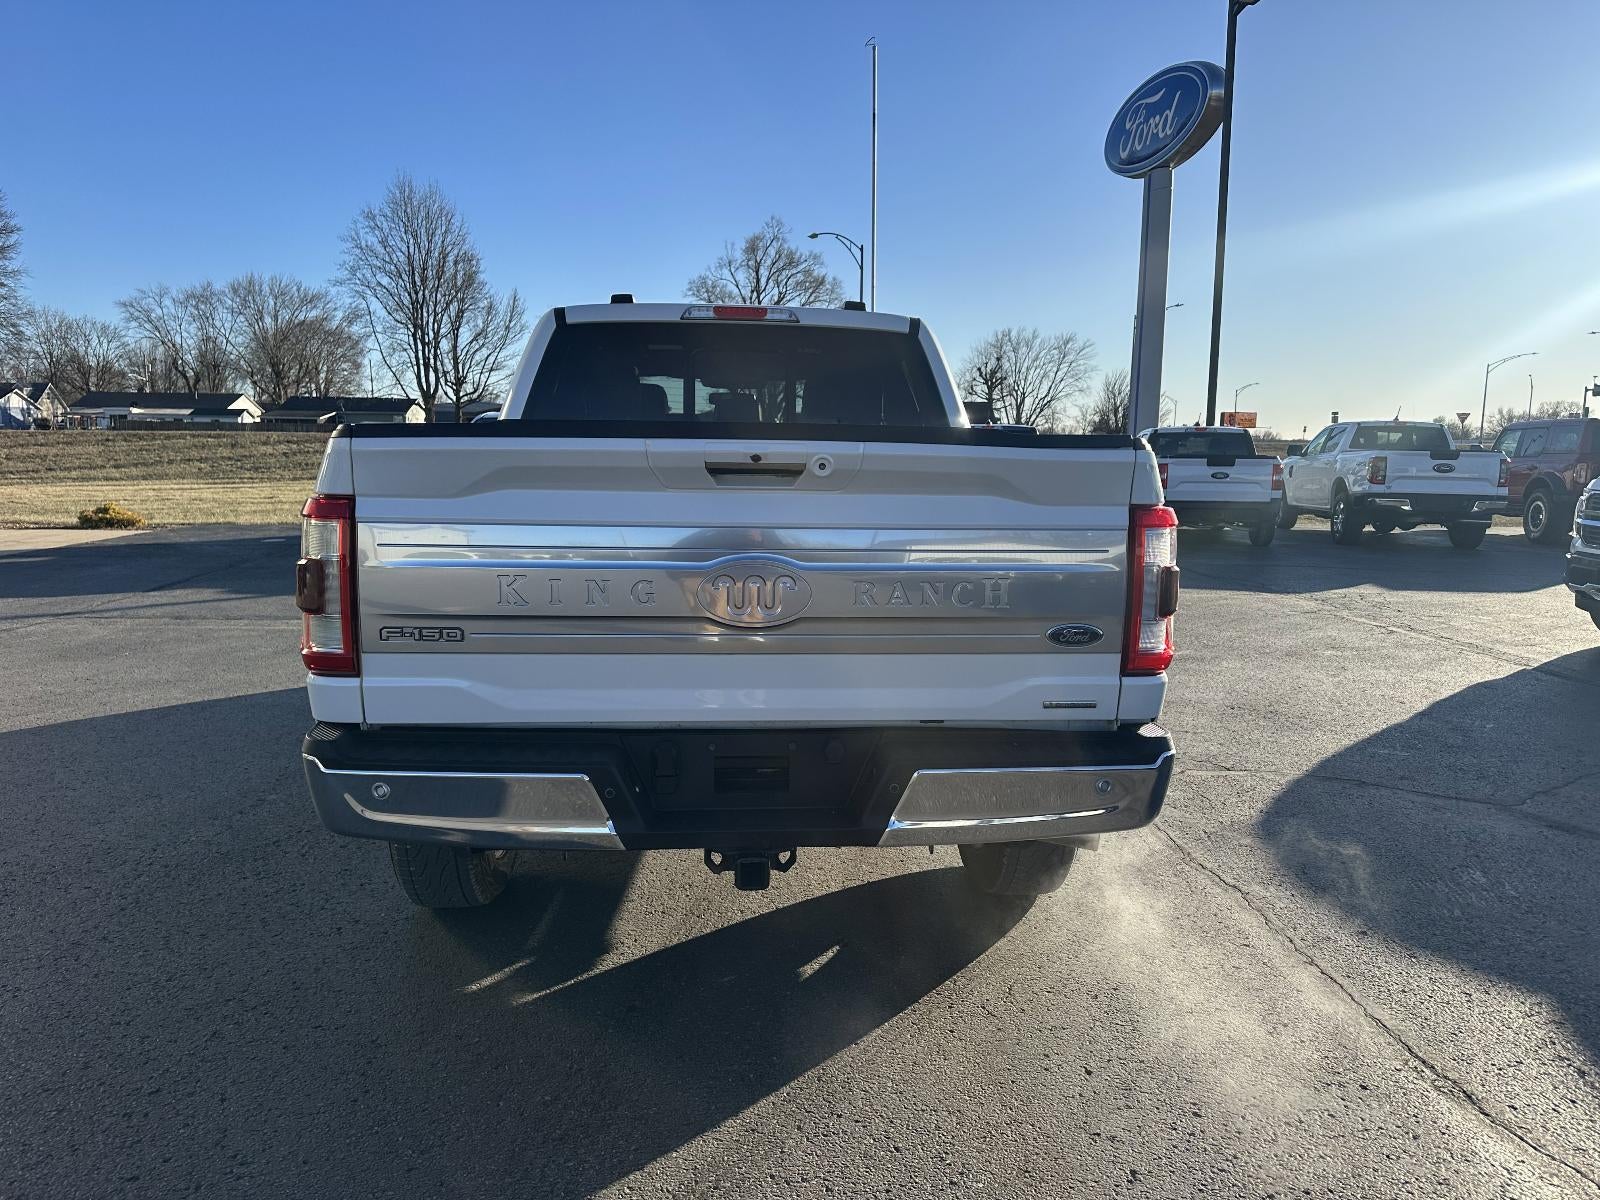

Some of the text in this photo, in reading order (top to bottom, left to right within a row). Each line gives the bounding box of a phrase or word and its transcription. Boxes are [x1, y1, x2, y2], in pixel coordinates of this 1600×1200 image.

[1119, 87, 1181, 160] Ford
[496, 574, 1011, 609] KING RANCH
[379, 626, 465, 642] F-150
[1059, 628, 1090, 643] Ford
